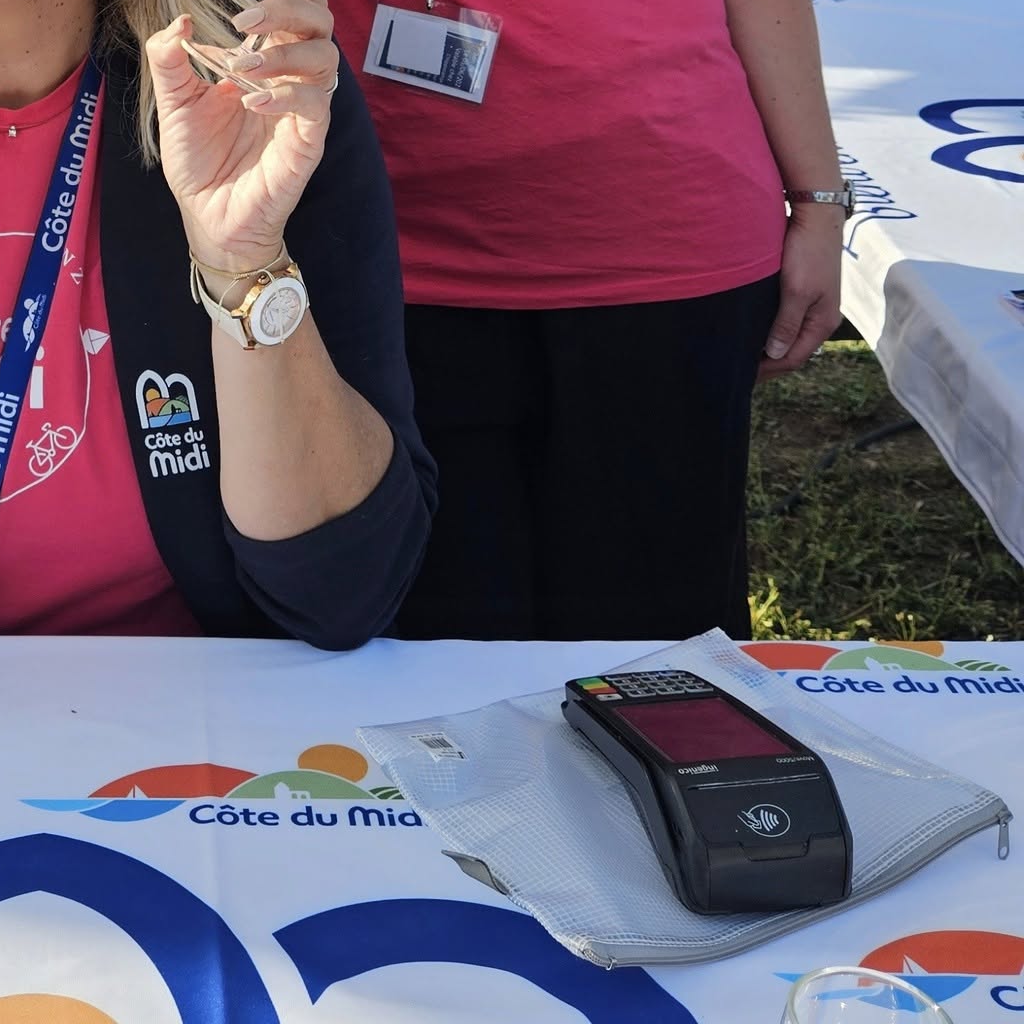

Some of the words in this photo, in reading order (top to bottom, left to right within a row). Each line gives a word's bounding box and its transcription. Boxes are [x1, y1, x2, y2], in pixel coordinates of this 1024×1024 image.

[41, 192, 75, 252] Côte
[60, 153, 85, 185] du
[145, 432, 182, 449] Côte
[184, 427, 204, 443] du
[795, 675, 885, 694] Côte
[893, 675, 940, 694] du
[677, 763, 719, 775] ingenico
[189, 804, 280, 826] Côte
[291, 806, 338, 826] du
[349, 806, 423, 827] Mid
